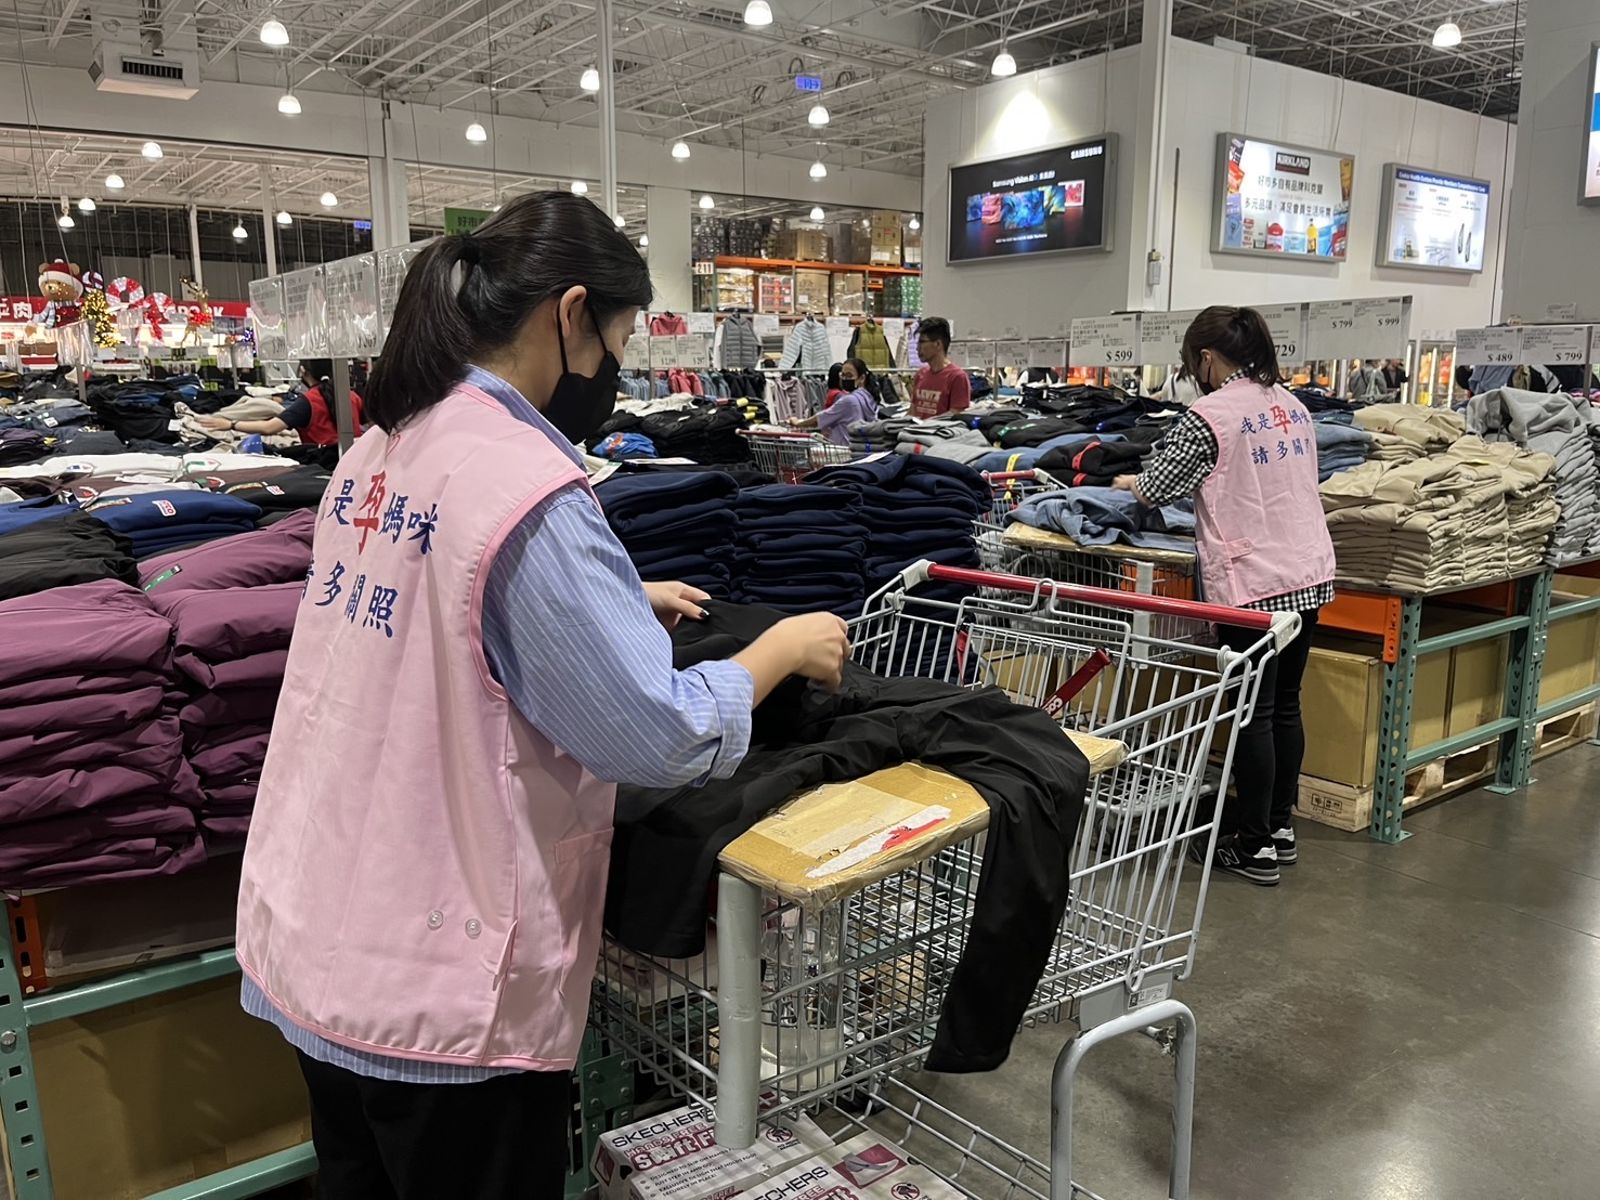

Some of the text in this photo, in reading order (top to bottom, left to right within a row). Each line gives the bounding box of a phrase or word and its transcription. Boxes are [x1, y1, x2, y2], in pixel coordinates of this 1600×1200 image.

[1070, 146, 1103, 160] SAMSUNG
[1276, 154, 1310, 169] KIRKLAND
[697, 263, 712, 274] 211
[1339, 320, 1353, 328] 799
[1385, 317, 1400, 326] 999
[1115, 349, 1133, 361] 599
[1274, 344, 1296, 357] 729
[1495, 353, 1513, 362] 489
[1564, 352, 1583, 361] 799
[324, 470, 438, 555] 是孕媽咪
